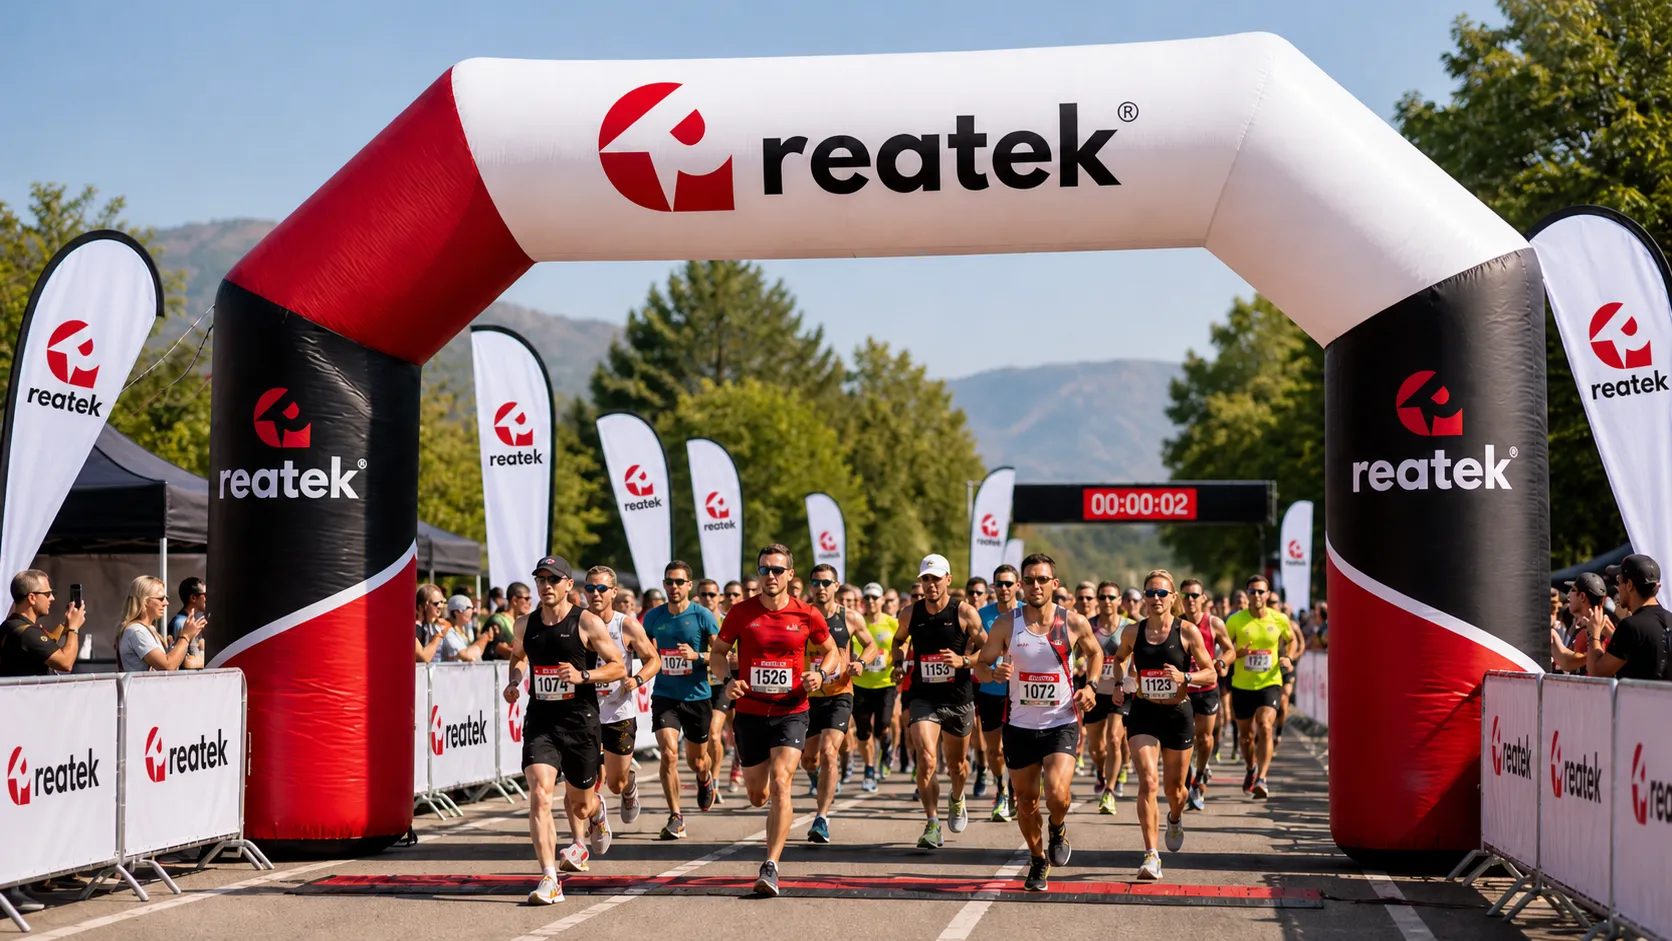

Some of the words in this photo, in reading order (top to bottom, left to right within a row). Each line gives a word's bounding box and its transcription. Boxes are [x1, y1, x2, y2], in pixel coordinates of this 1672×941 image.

[1591, 370, 1669, 400] reatek
[27, 387, 102, 417] reatek
[490, 448, 543, 466] reatek
[624, 496, 662, 511] reatek
[1091, 493, 1188, 515] 00:00:02
[704, 520, 736, 531] reatek
[755, 669, 787, 685] 1526
[1145, 679, 1172, 691] 1123
[1023, 683, 1056, 699] 1072
[446, 710, 487, 749] reatek
[169, 729, 228, 775] reatek
[1502, 734, 1532, 780] reatek
[35, 748, 99, 797] reatek
[1564, 751, 1602, 804] reatek
